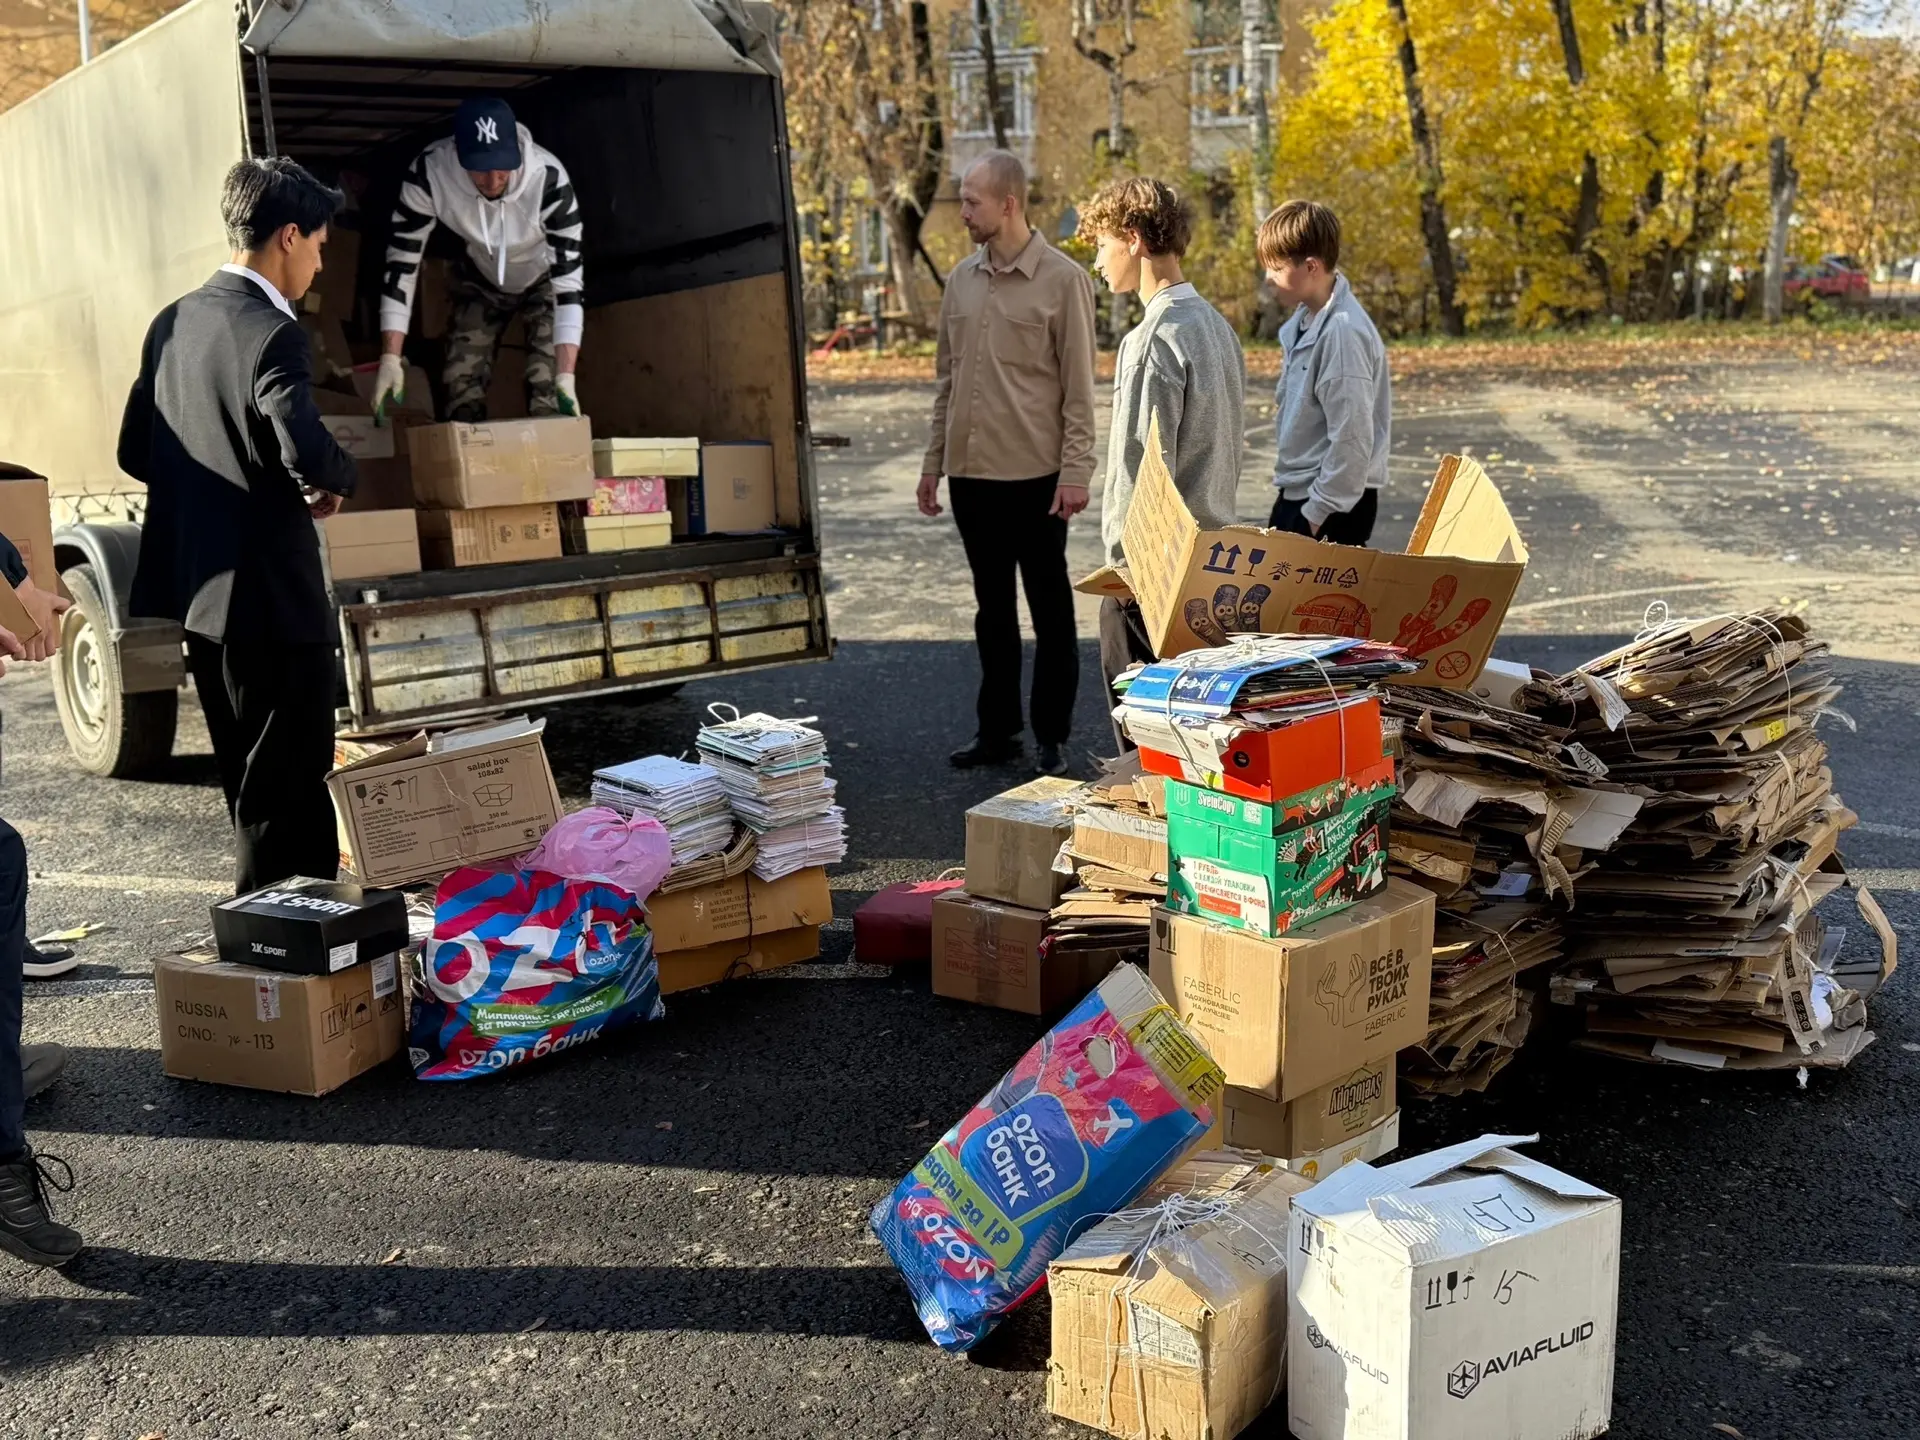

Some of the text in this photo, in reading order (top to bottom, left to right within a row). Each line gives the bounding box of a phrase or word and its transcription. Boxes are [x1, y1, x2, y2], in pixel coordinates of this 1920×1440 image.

[475, 116, 499, 144] NY
[467, 757, 510, 772] salad box
[477, 767, 504, 779] 108x82
[1197, 790, 1236, 817] SvetoCopy
[251, 891, 362, 916] 2K SPORT
[251, 942, 287, 957] 2K SPORT
[1395, 948, 1404, 966] В
[1183, 975, 1241, 1005] FABERLIC
[1368, 962, 1411, 994] ТВОИХ
[174, 999, 229, 1020] RUSSIA
[1192, 1002, 1202, 1011] НА
[1366, 980, 1408, 1013] РУКАХ
[177, 1024, 218, 1044] C/NO:
[476, 1021, 493, 1032] за
[1364, 1007, 1407, 1034] FABERLIC
[459, 1024, 604, 1070] ozon банк
[1328, 1071, 1383, 1116] SvetoCopy
[1012, 1113, 1056, 1189] ozon
[986, 1125, 1030, 1208] банк
[904, 1195, 924, 1218] на
[958, 1197, 985, 1228] за
[923, 1213, 989, 1284] OZON
[1323, 1337, 1390, 1385] AVIAFLUID
[1481, 1320, 1595, 1380] AVIAFLUID
